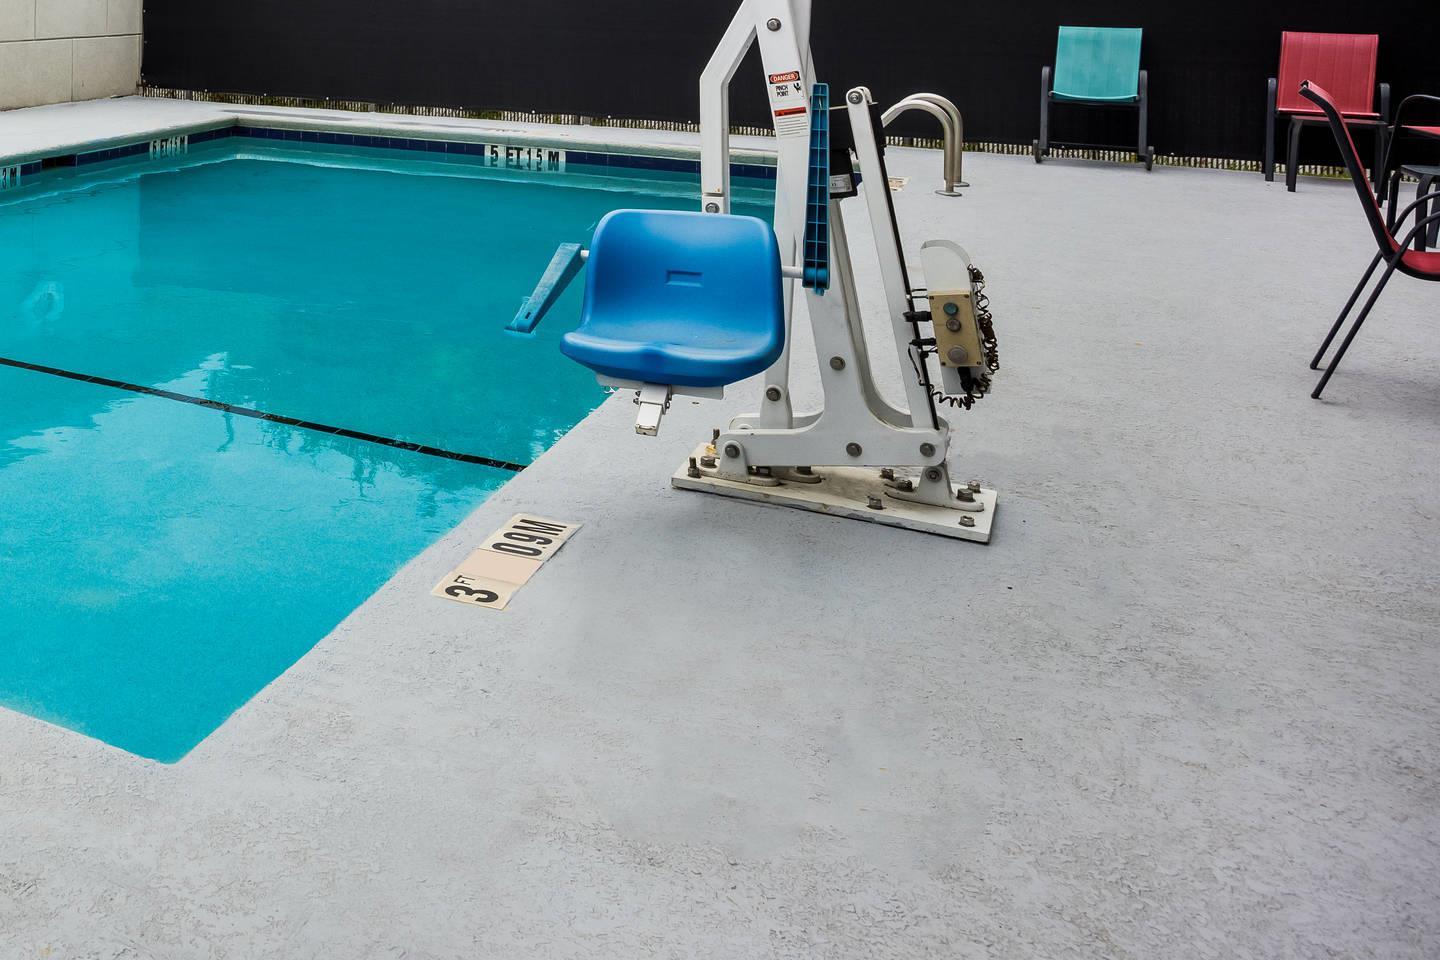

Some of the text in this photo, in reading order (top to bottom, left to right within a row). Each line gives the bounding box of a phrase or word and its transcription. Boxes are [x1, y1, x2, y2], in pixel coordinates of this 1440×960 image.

[773, 73, 796, 82] DANGER
[506, 146, 524, 160] FT
[548, 151, 560, 162] M
